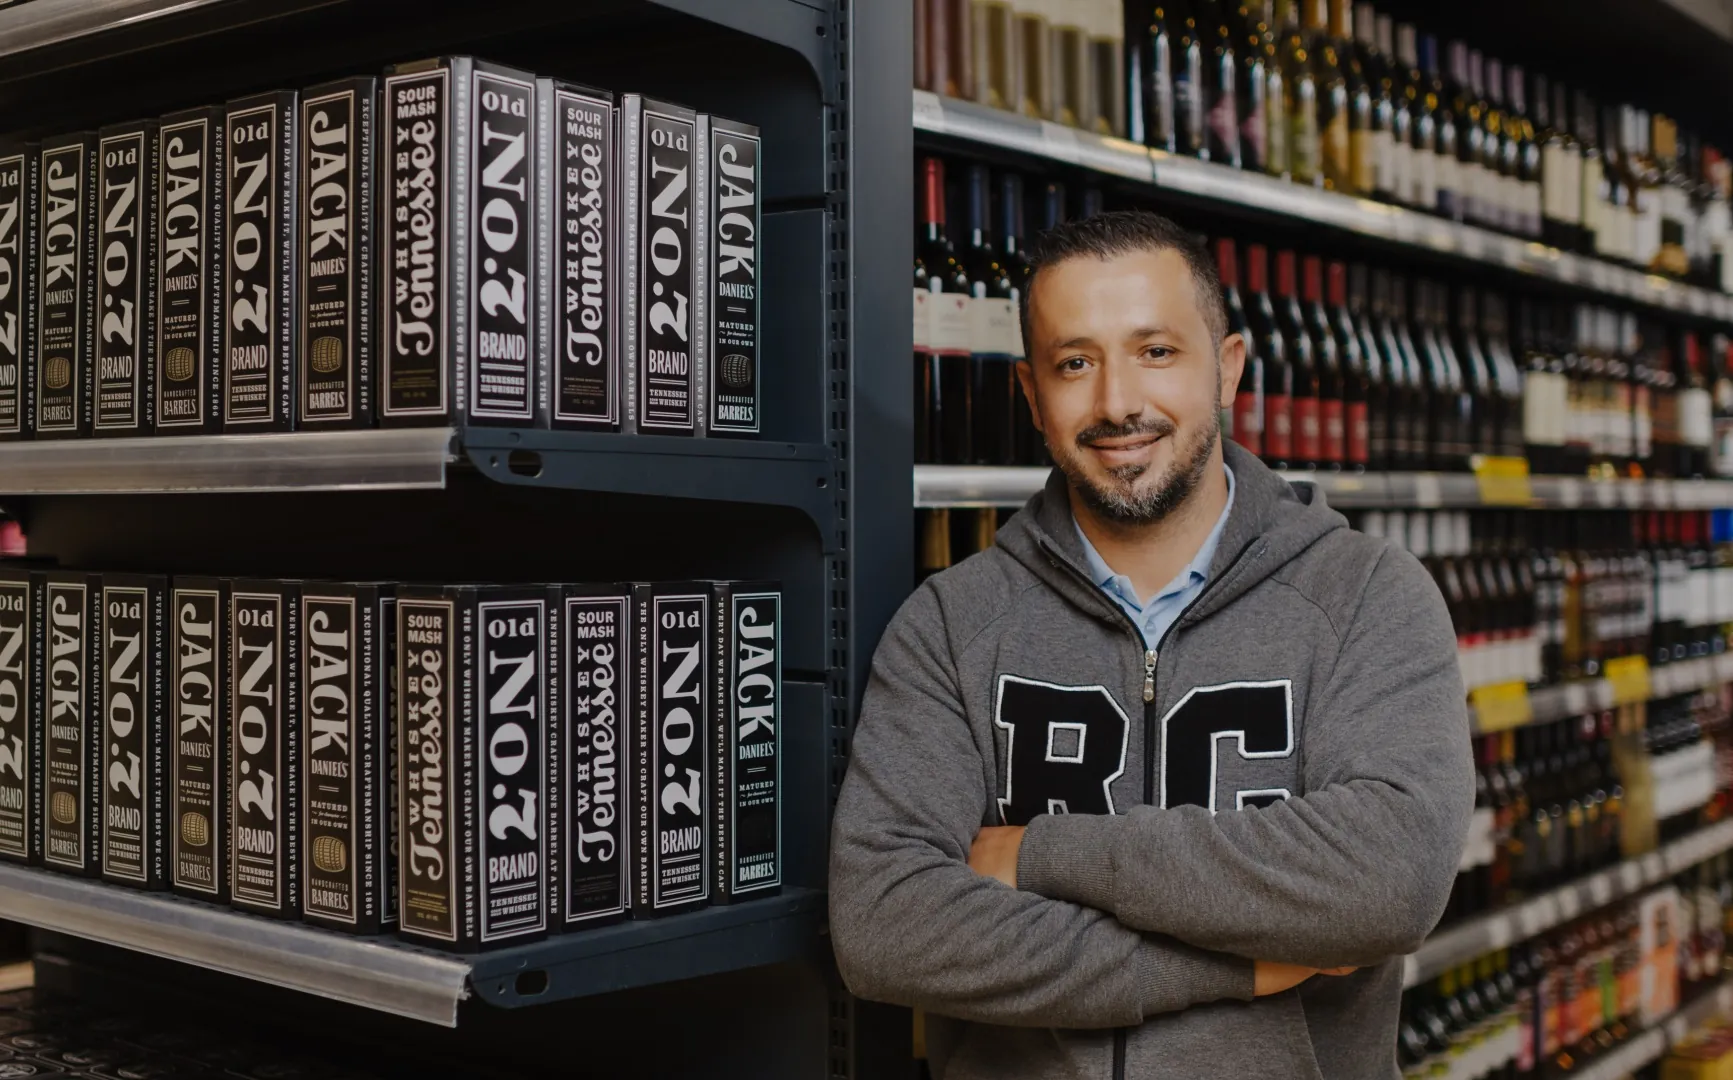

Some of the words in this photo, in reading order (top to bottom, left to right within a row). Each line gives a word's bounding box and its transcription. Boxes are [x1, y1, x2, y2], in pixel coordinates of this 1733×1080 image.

[398, 85, 436, 104] SOUR
[482, 90, 526, 117] Old
[397, 101, 436, 119] MASH
[567, 107, 602, 126] SOUR
[233, 122, 269, 144] Old
[361, 98, 369, 178] EXCEPTIONAL
[567, 122, 602, 140] MASH
[651, 128, 688, 152] Old
[105, 148, 137, 168] Old
[0, 170, 19, 187] ld
[310, 110, 347, 258] JACK
[166, 137, 200, 274] JACK
[361, 181, 369, 231] QUALITY
[719, 143, 754, 279] JACK
[46, 160, 77, 288] JACK
[396, 126, 409, 305] WHISKEY
[566, 141, 578, 314] WHISKEY
[361, 234, 369, 242] &
[396, 120, 435, 355] Tennessee
[567, 143, 602, 366] Tennessee
[309, 301, 345, 311] MATURED
[164, 314, 197, 324] MATURED
[719, 321, 754, 331] MATURED
[45, 327, 73, 336] MATURED
[480, 331, 526, 361] BRAND
[728, 338, 740, 346] OUR
[232, 344, 267, 371] BRAND
[649, 349, 688, 375] BRAND
[101, 355, 133, 380] BRAND
[232, 384, 267, 394] TENNESSEE
[480, 374, 525, 386] TENNESSEE
[309, 391, 345, 409] BARRELS
[649, 389, 687, 399] TENNESSEE
[658, 398, 687, 407] WHISKEY
[43, 405, 72, 421] BARRELS
[164, 399, 197, 416] BARRELS
[718, 405, 753, 421] BARRELS
[109, 601, 140, 619] Old
[238, 608, 274, 627] Old
[577, 611, 614, 624] SOUR
[661, 610, 700, 629] Old
[408, 614, 442, 629] SOUR
[488, 617, 535, 638] Old
[408, 630, 442, 644] MASH
[577, 626, 614, 639] MASH
[52, 595, 80, 721] JACK
[180, 602, 212, 737] JACK
[289, 662, 296, 678] WE
[737, 606, 774, 742] JACK
[309, 610, 348, 756] JACK
[464, 669, 472, 726] WHISKEY
[364, 690, 372, 739] QUALITY
[408, 650, 420, 825] WHISKEY
[577, 646, 590, 817] WHISKEY
[464, 727, 472, 767] MAKER
[578, 643, 615, 863] Tennessee
[51, 761, 78, 771] MATURED
[409, 650, 443, 881] Tennessee
[641, 751, 647, 765] TO
[180, 779, 211, 790] MATURED
[465, 771, 472, 786] TO
[739, 780, 774, 791] MATURED
[0, 786, 22, 809] RAND
[289, 797, 296, 808] IT
[311, 800, 348, 812] MATURED
[364, 754, 372, 850] CRAFTSMANSHIP
[109, 804, 140, 831] BRAND
[319, 819, 332, 827] OUR
[333, 821, 348, 830] OWN
[51, 838, 78, 856] BARRELS
[238, 826, 274, 854] BRAND
[661, 826, 700, 854] BRAND
[180, 861, 211, 882] BARRELS
[238, 864, 274, 878] TENNESSEE
[289, 863, 296, 880] WE
[365, 854, 373, 888] SINCE
[465, 857, 473, 883] OWN
[489, 851, 537, 883] BRAND
[550, 858, 557, 872] AT
[662, 864, 700, 877] TENNESSEE
[739, 861, 774, 882] BARRELS
[671, 872, 700, 884] WHISKEY
[312, 888, 349, 910] BARRELS
[365, 891, 373, 916] 1866
[490, 892, 537, 908] TENNESSEE
[502, 902, 537, 915] WHISKEY
[465, 886, 473, 938] BARRELS
